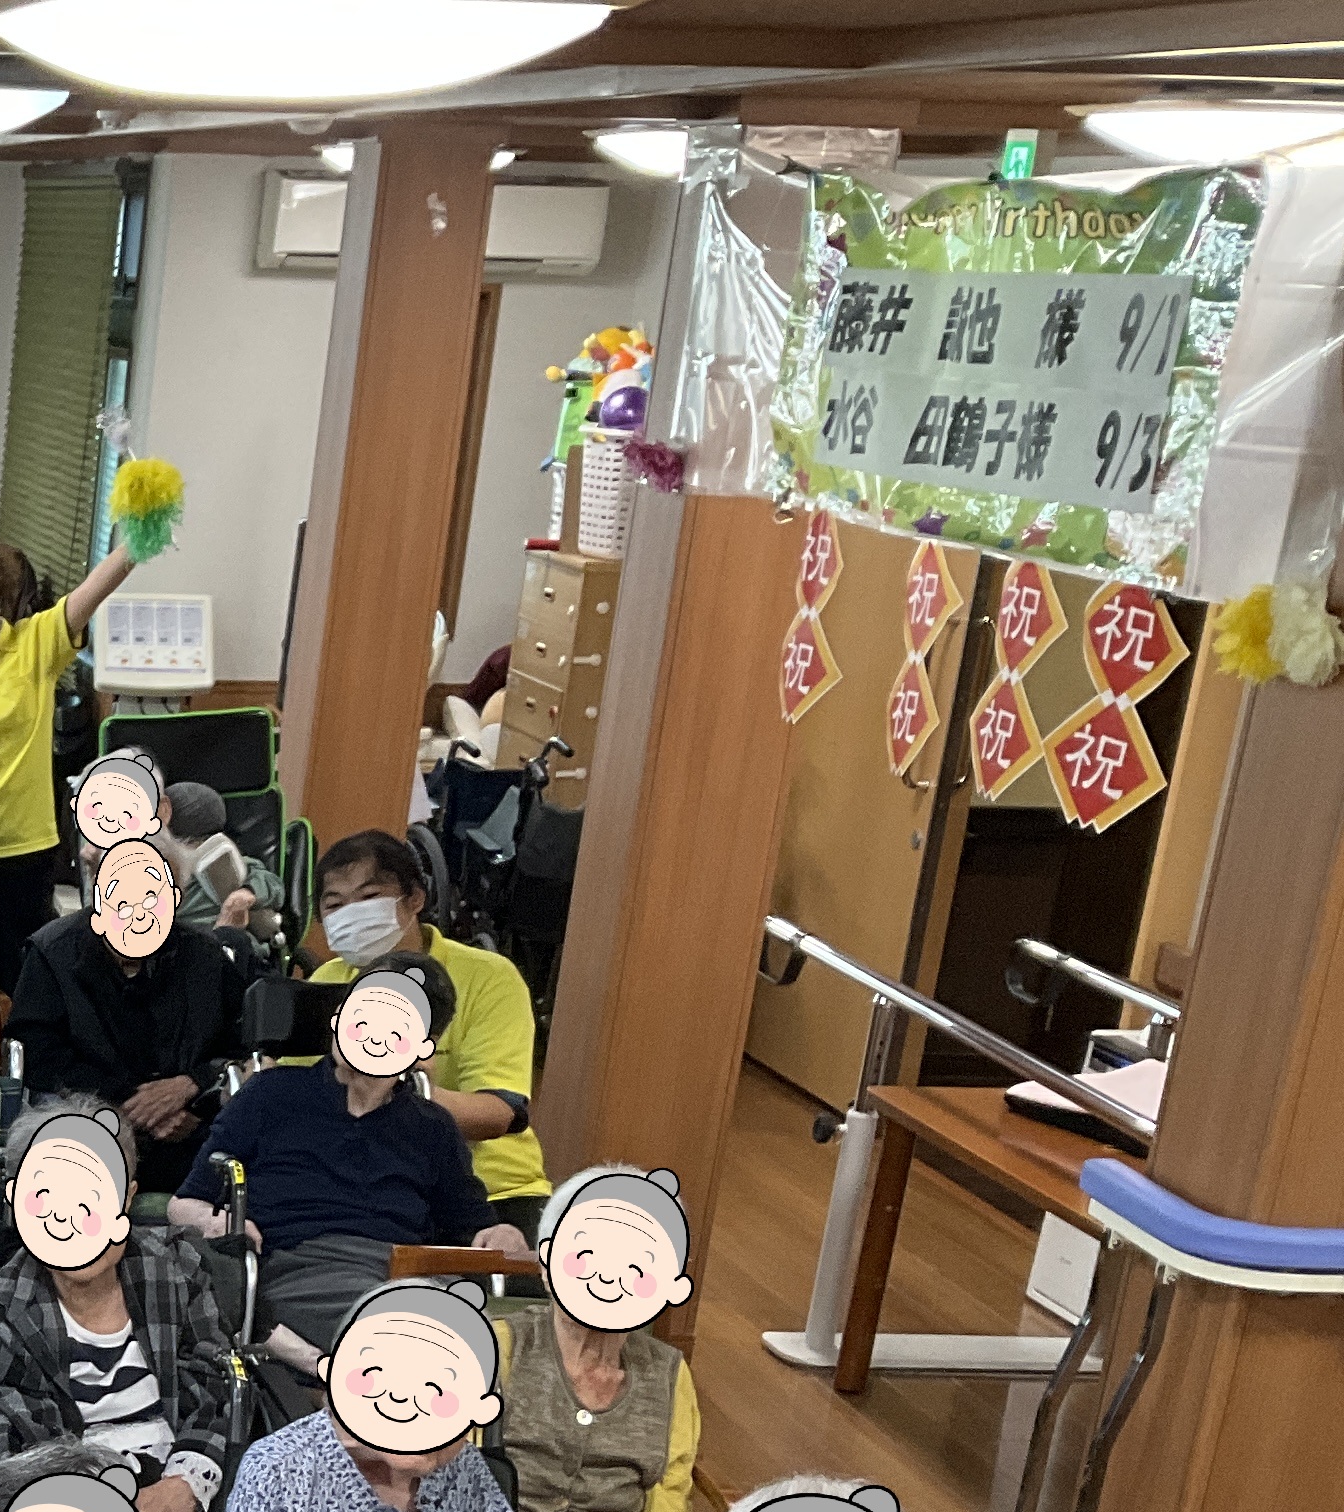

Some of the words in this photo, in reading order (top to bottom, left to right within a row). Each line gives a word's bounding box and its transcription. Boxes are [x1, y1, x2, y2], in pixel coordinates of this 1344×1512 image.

[829, 281, 913, 356] 藤井
[1035, 288, 1085, 369] 様
[822, 380, 879, 455] 水谷
[801, 532, 832, 586] 祝
[909, 569, 940, 627] 祝
[1001, 576, 1040, 646] 祝
[784, 637, 813, 694] 祝
[1095, 596, 1156, 672] 祝
[892, 684, 919, 743] 祝
[979, 699, 1015, 769] 祝
[1066, 723, 1129, 800] 祝
